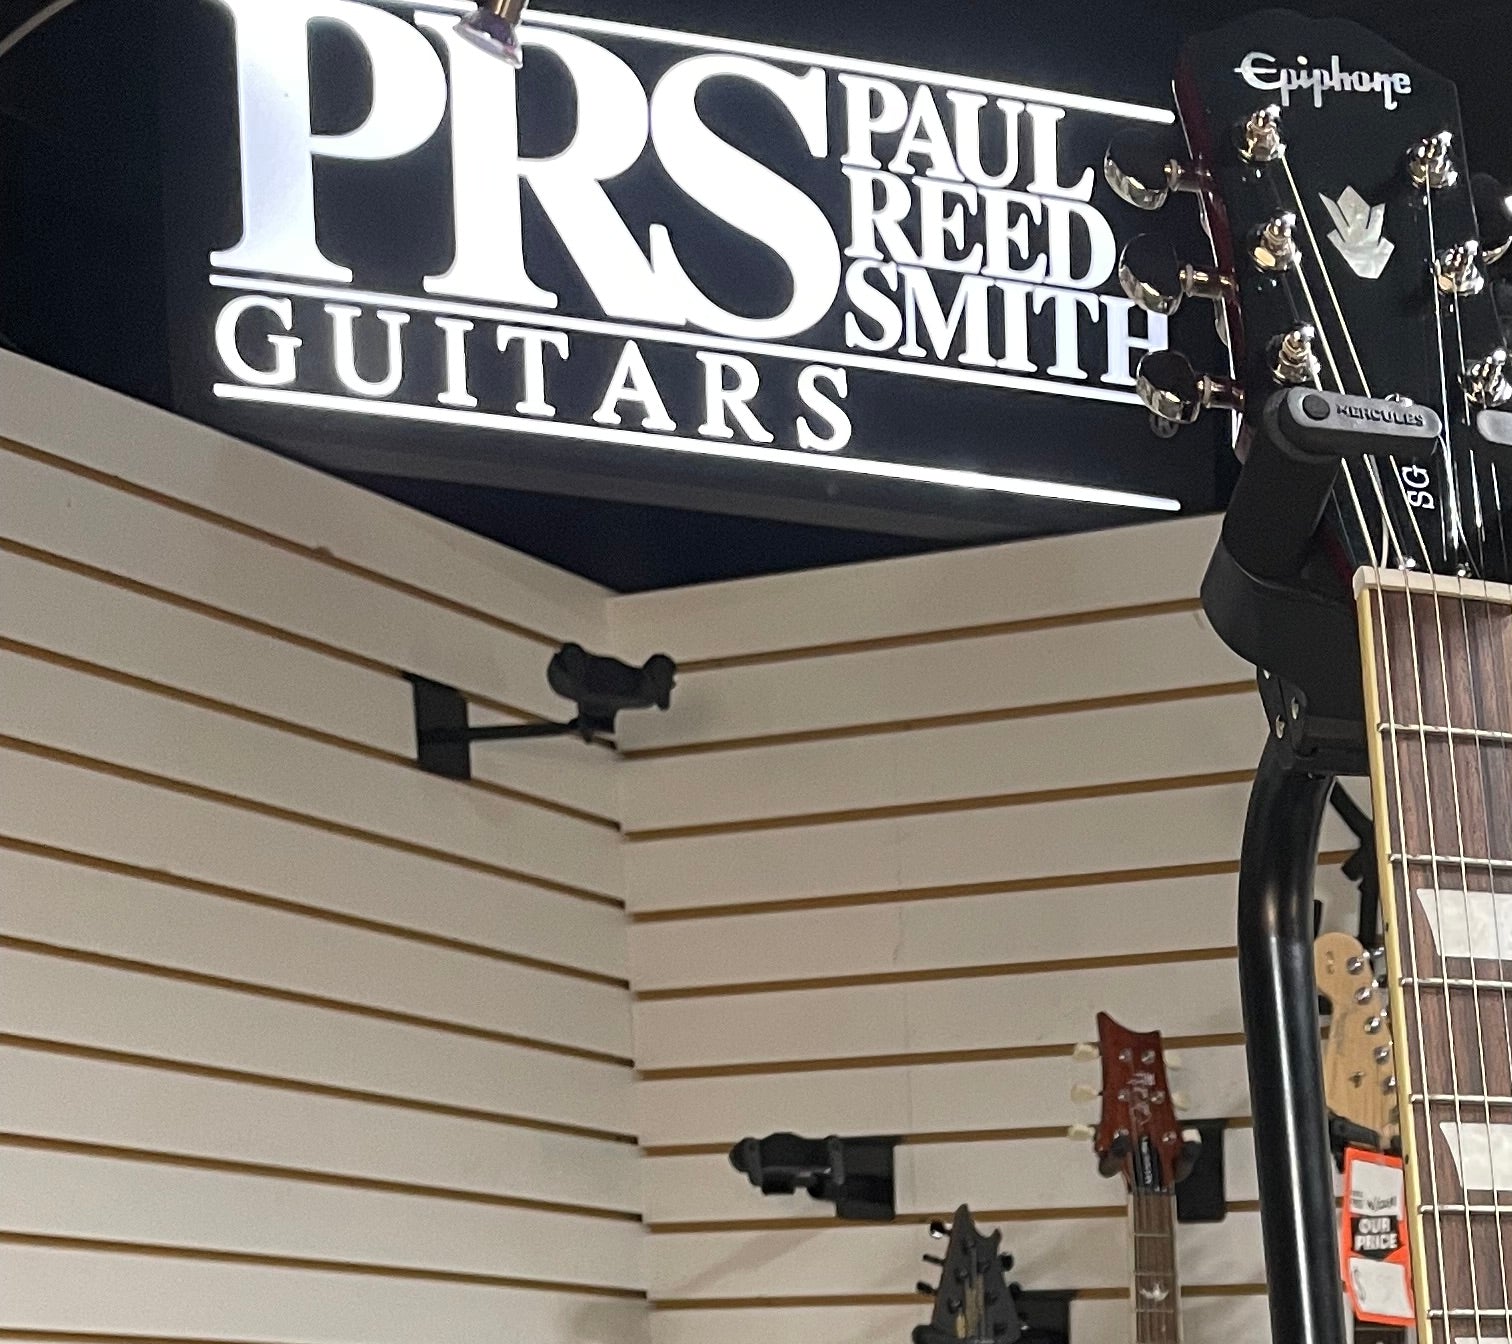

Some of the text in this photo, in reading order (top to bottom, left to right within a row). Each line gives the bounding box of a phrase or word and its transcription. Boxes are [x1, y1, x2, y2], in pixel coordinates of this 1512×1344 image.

[1234, 51, 1412, 110] Epiphone
[208, 0, 842, 340] PRS
[840, 73, 1095, 200] PAUL
[840, 165, 1117, 288] REED
[844, 260, 1168, 389] SMITH
[214, 296, 855, 451] GUITARS
[1335, 403, 1425, 427] HERCULES
[1402, 465, 1435, 509] SG
[1354, 1233, 1398, 1251] PRICE
[1359, 1217, 1391, 1234] OUR
